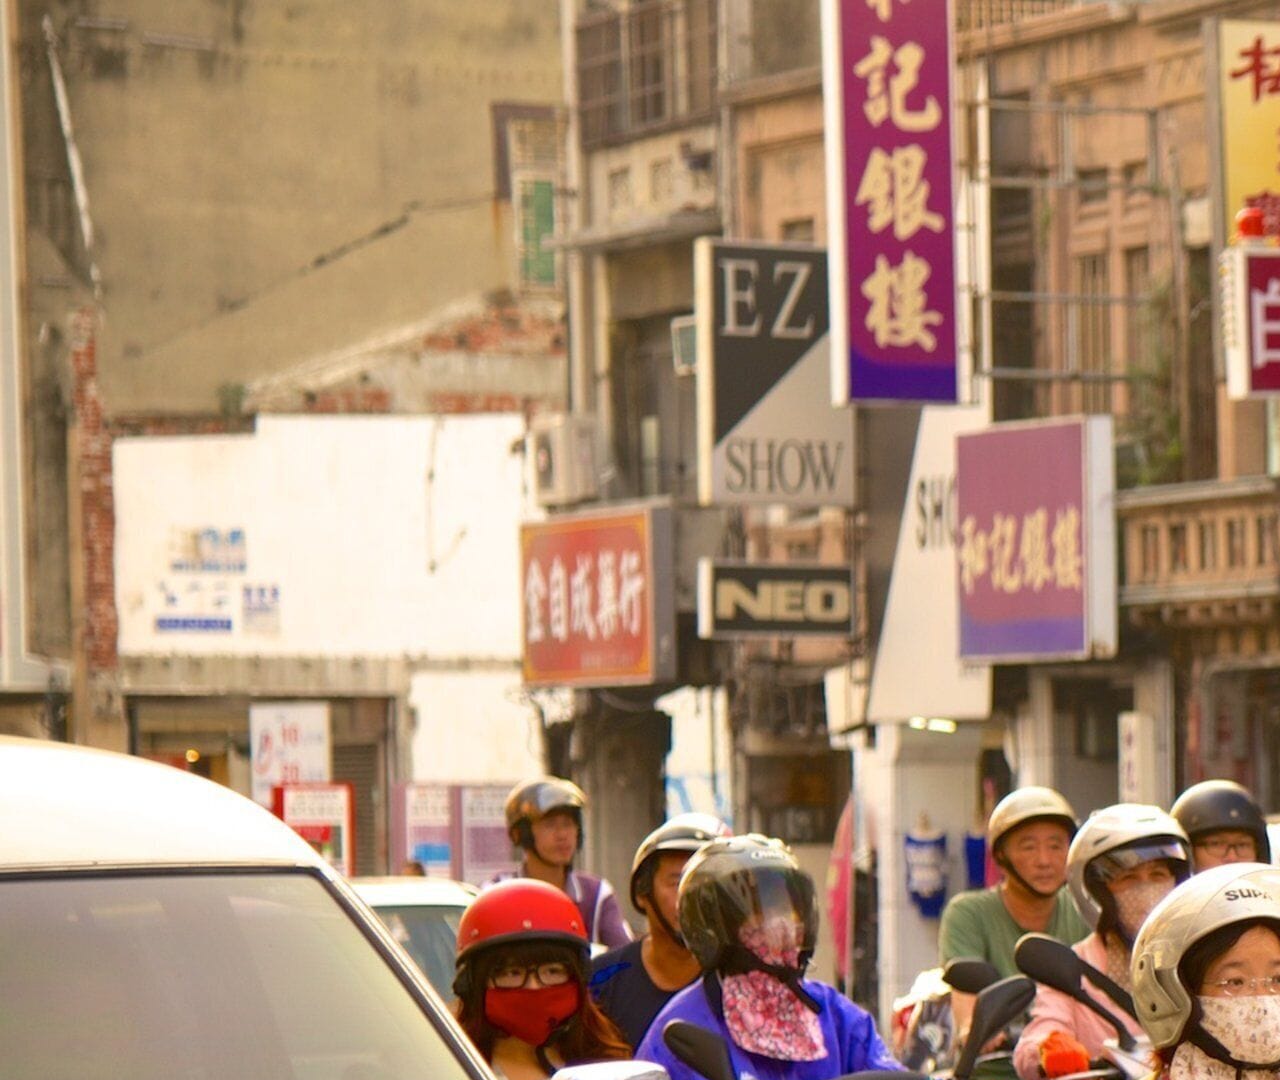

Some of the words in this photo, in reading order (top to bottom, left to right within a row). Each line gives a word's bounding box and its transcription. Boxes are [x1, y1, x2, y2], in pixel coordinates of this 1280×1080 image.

[854, 0, 946, 352] 記銀樓
[719, 258, 816, 339] EZ
[724, 436, 844, 495] SHOW
[716, 580, 850, 622] NEO
